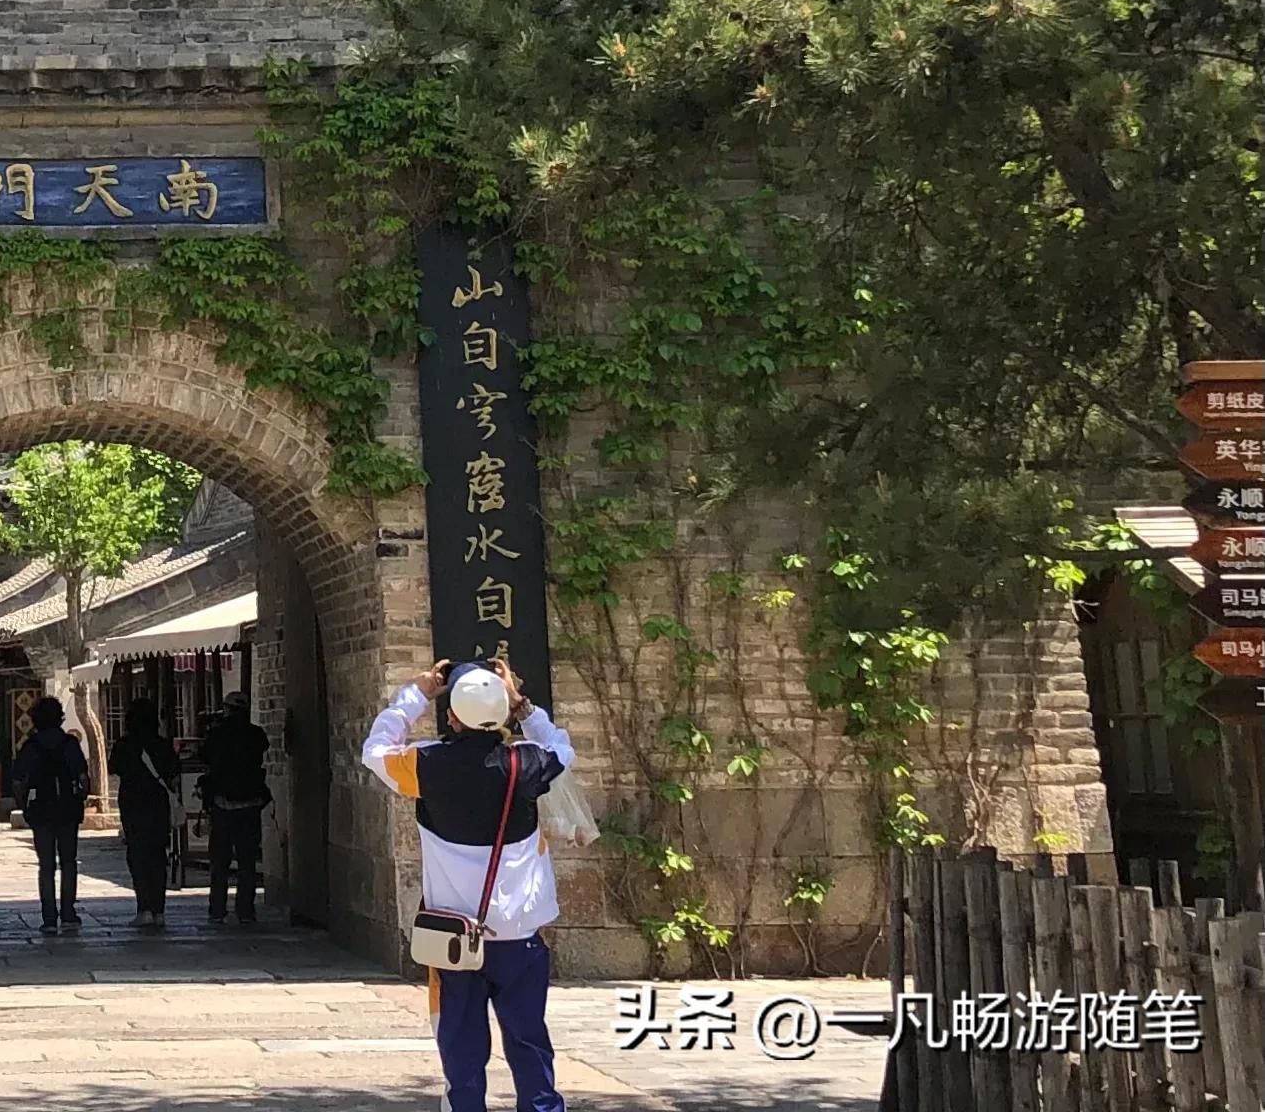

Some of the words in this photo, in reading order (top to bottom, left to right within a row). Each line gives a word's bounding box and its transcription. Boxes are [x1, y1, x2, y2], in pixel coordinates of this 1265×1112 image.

[1215, 439, 1265, 460] 英华
[1217, 488, 1264, 508] 永顺
[1221, 536, 1265, 557] 永顺
[1221, 588, 1265, 606] 司马
